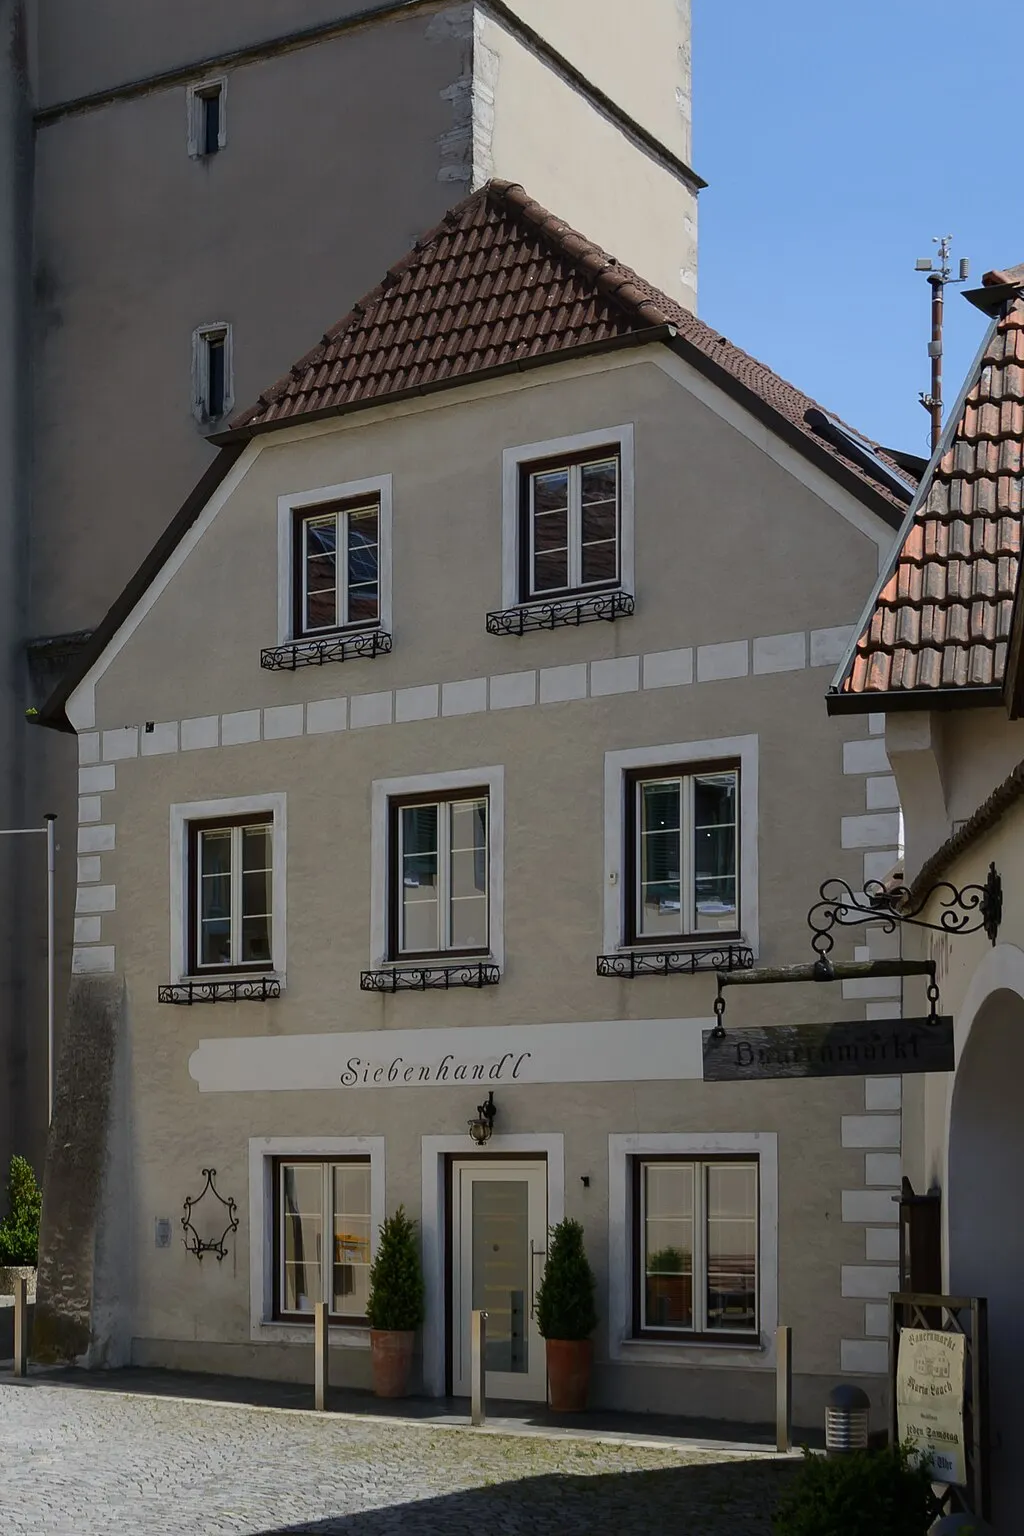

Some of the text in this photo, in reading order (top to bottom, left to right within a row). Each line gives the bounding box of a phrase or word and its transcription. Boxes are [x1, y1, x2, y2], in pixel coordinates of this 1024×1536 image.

[340, 1052, 532, 1087] Siebenhandl
[908, 1332, 956, 1352] Bauernmarkt
[907, 1375, 929, 1396] Maria
